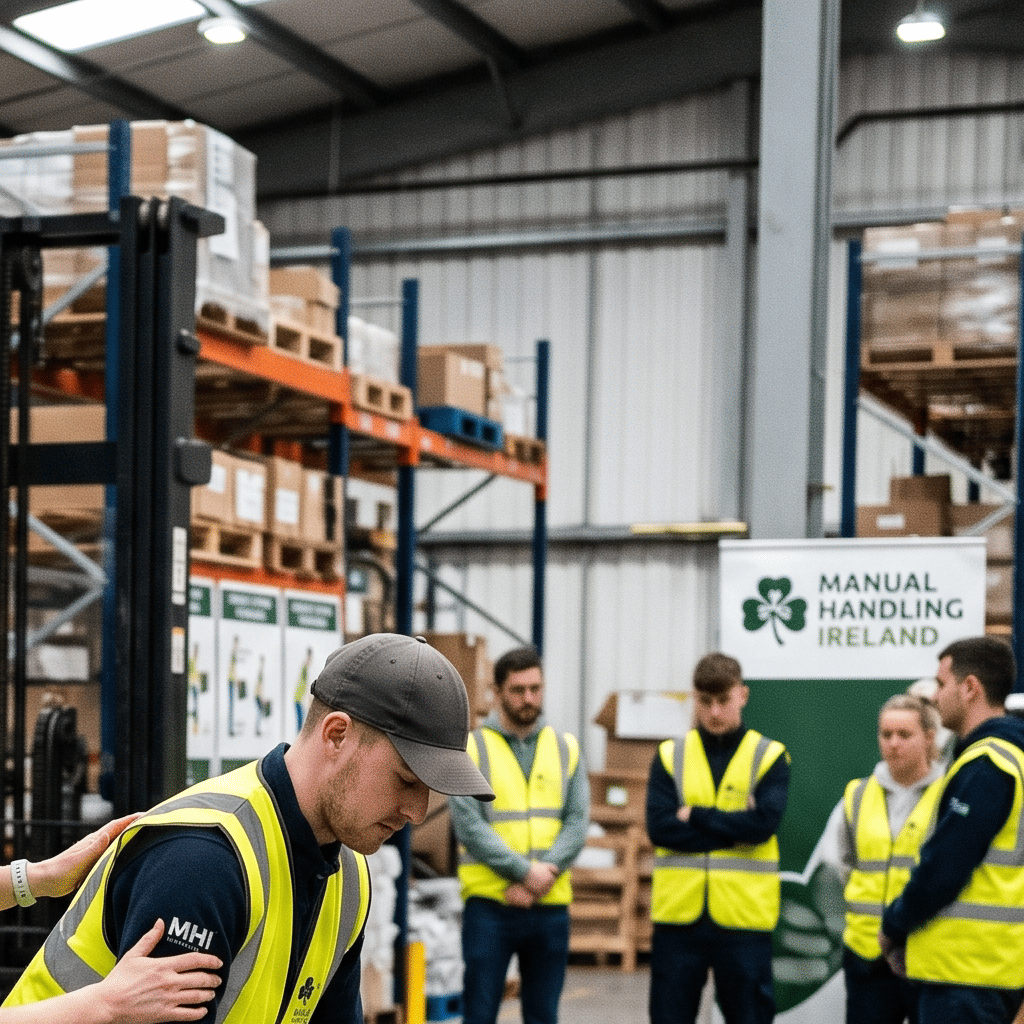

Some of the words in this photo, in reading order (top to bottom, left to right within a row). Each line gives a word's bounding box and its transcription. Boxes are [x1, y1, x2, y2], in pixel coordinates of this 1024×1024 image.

[818, 572, 937, 593] MANUAL
[818, 598, 964, 620] HANDLING
[818, 626, 940, 647] IRELAND
[167, 916, 214, 950] MHI
